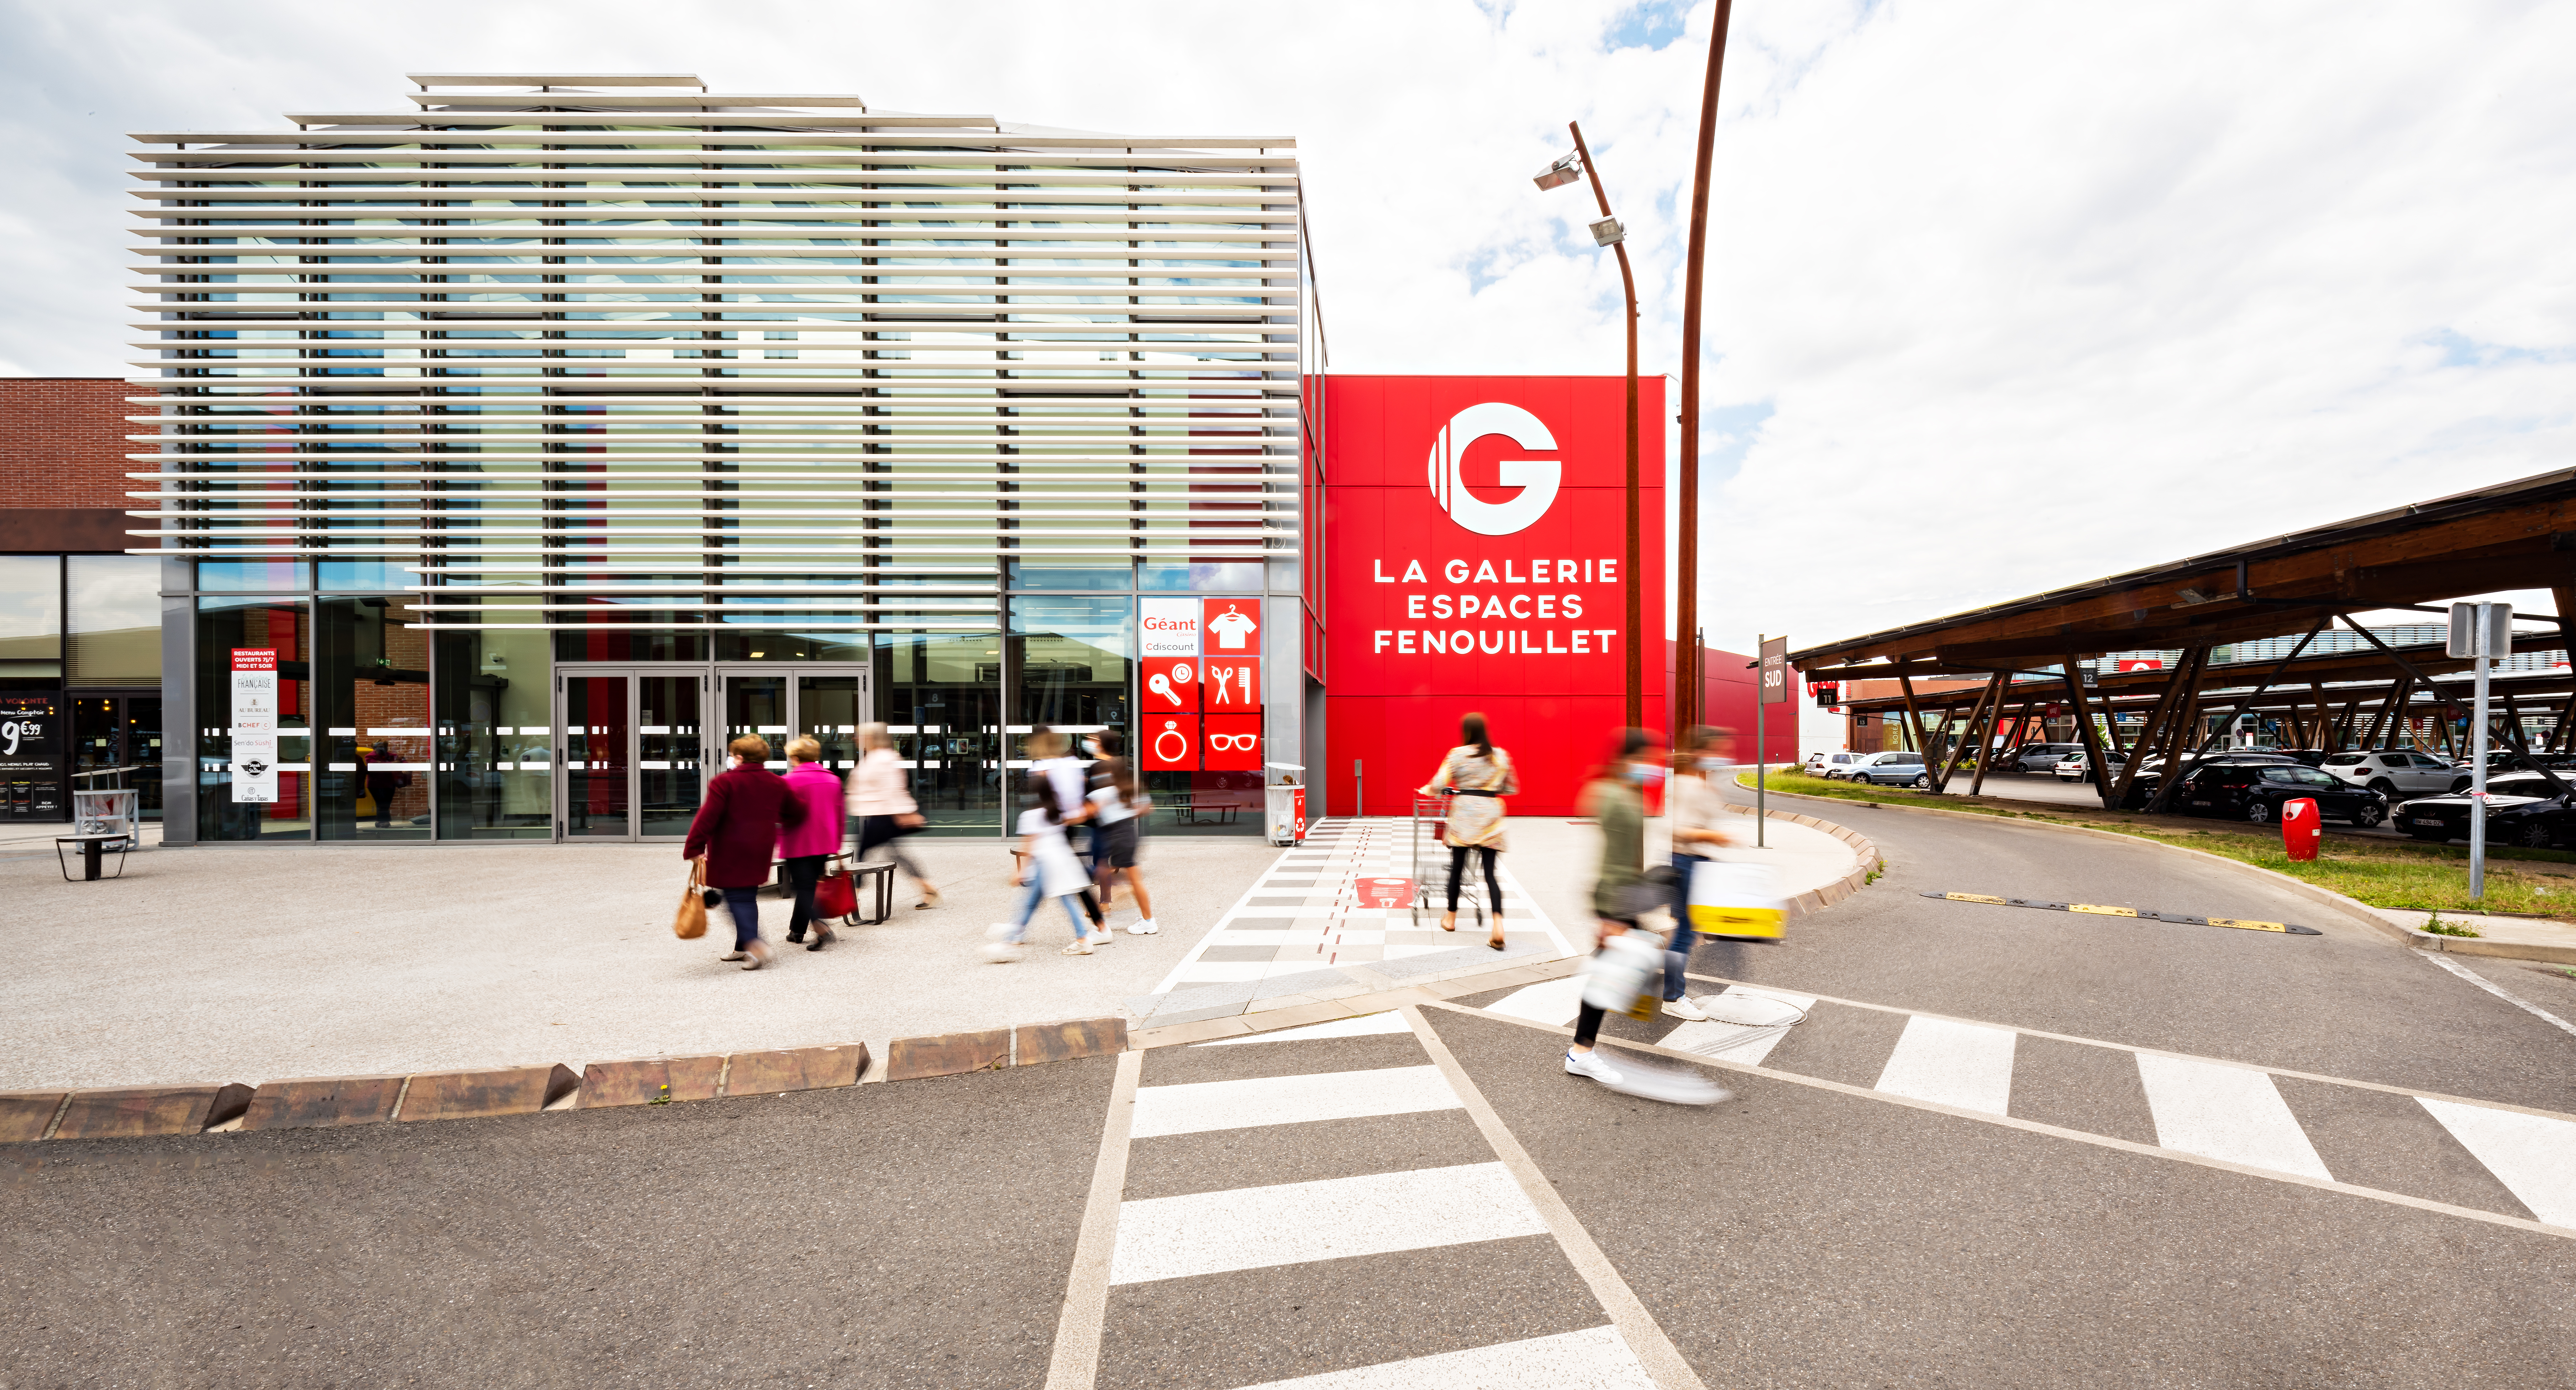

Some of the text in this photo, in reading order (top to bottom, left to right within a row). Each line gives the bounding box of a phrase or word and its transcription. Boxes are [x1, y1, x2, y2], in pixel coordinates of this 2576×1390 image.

[1375, 559, 1617, 583] LA GALERIE
[1408, 594, 1582, 619] ESPACES
[1144, 617, 1196, 630] Géant
[1375, 630, 1616, 654] FENOUILLET
[1765, 654, 1782, 667] ENTRÉE
[238, 679, 271, 689] FRANÇAISE
[1765, 670, 1782, 688] SUD
[2083, 674, 2093, 682] 12
[1824, 695, 1831, 703] 11
